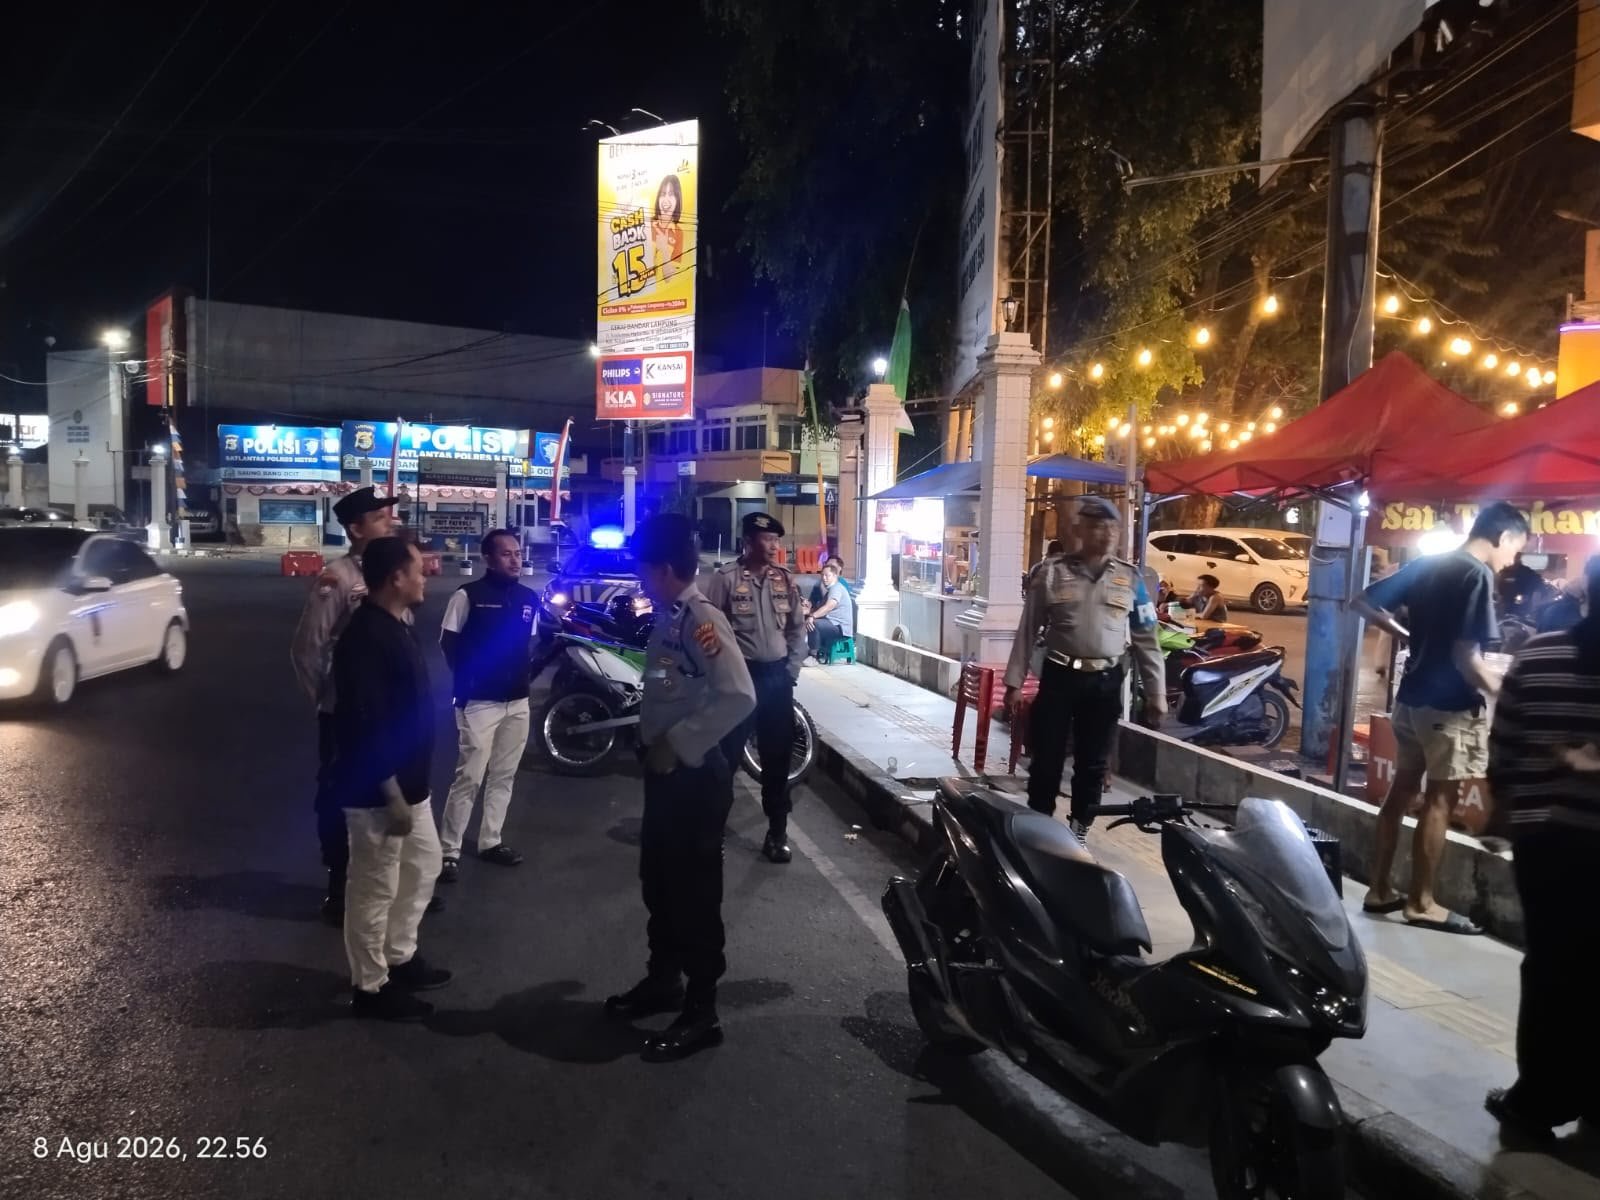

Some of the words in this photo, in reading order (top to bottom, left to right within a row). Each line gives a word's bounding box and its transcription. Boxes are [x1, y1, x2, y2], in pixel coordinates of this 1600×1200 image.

[610, 207, 645, 234] CASH
[612, 244, 647, 297] 15
[602, 368, 631, 378] PHILIPS
[657, 363, 683, 371] KANSAI
[605, 390, 636, 404] KIA
[652, 391, 685, 399] SIGNATURE
[243, 438, 300, 454] POLISI
[411, 427, 513, 454] POLISI
